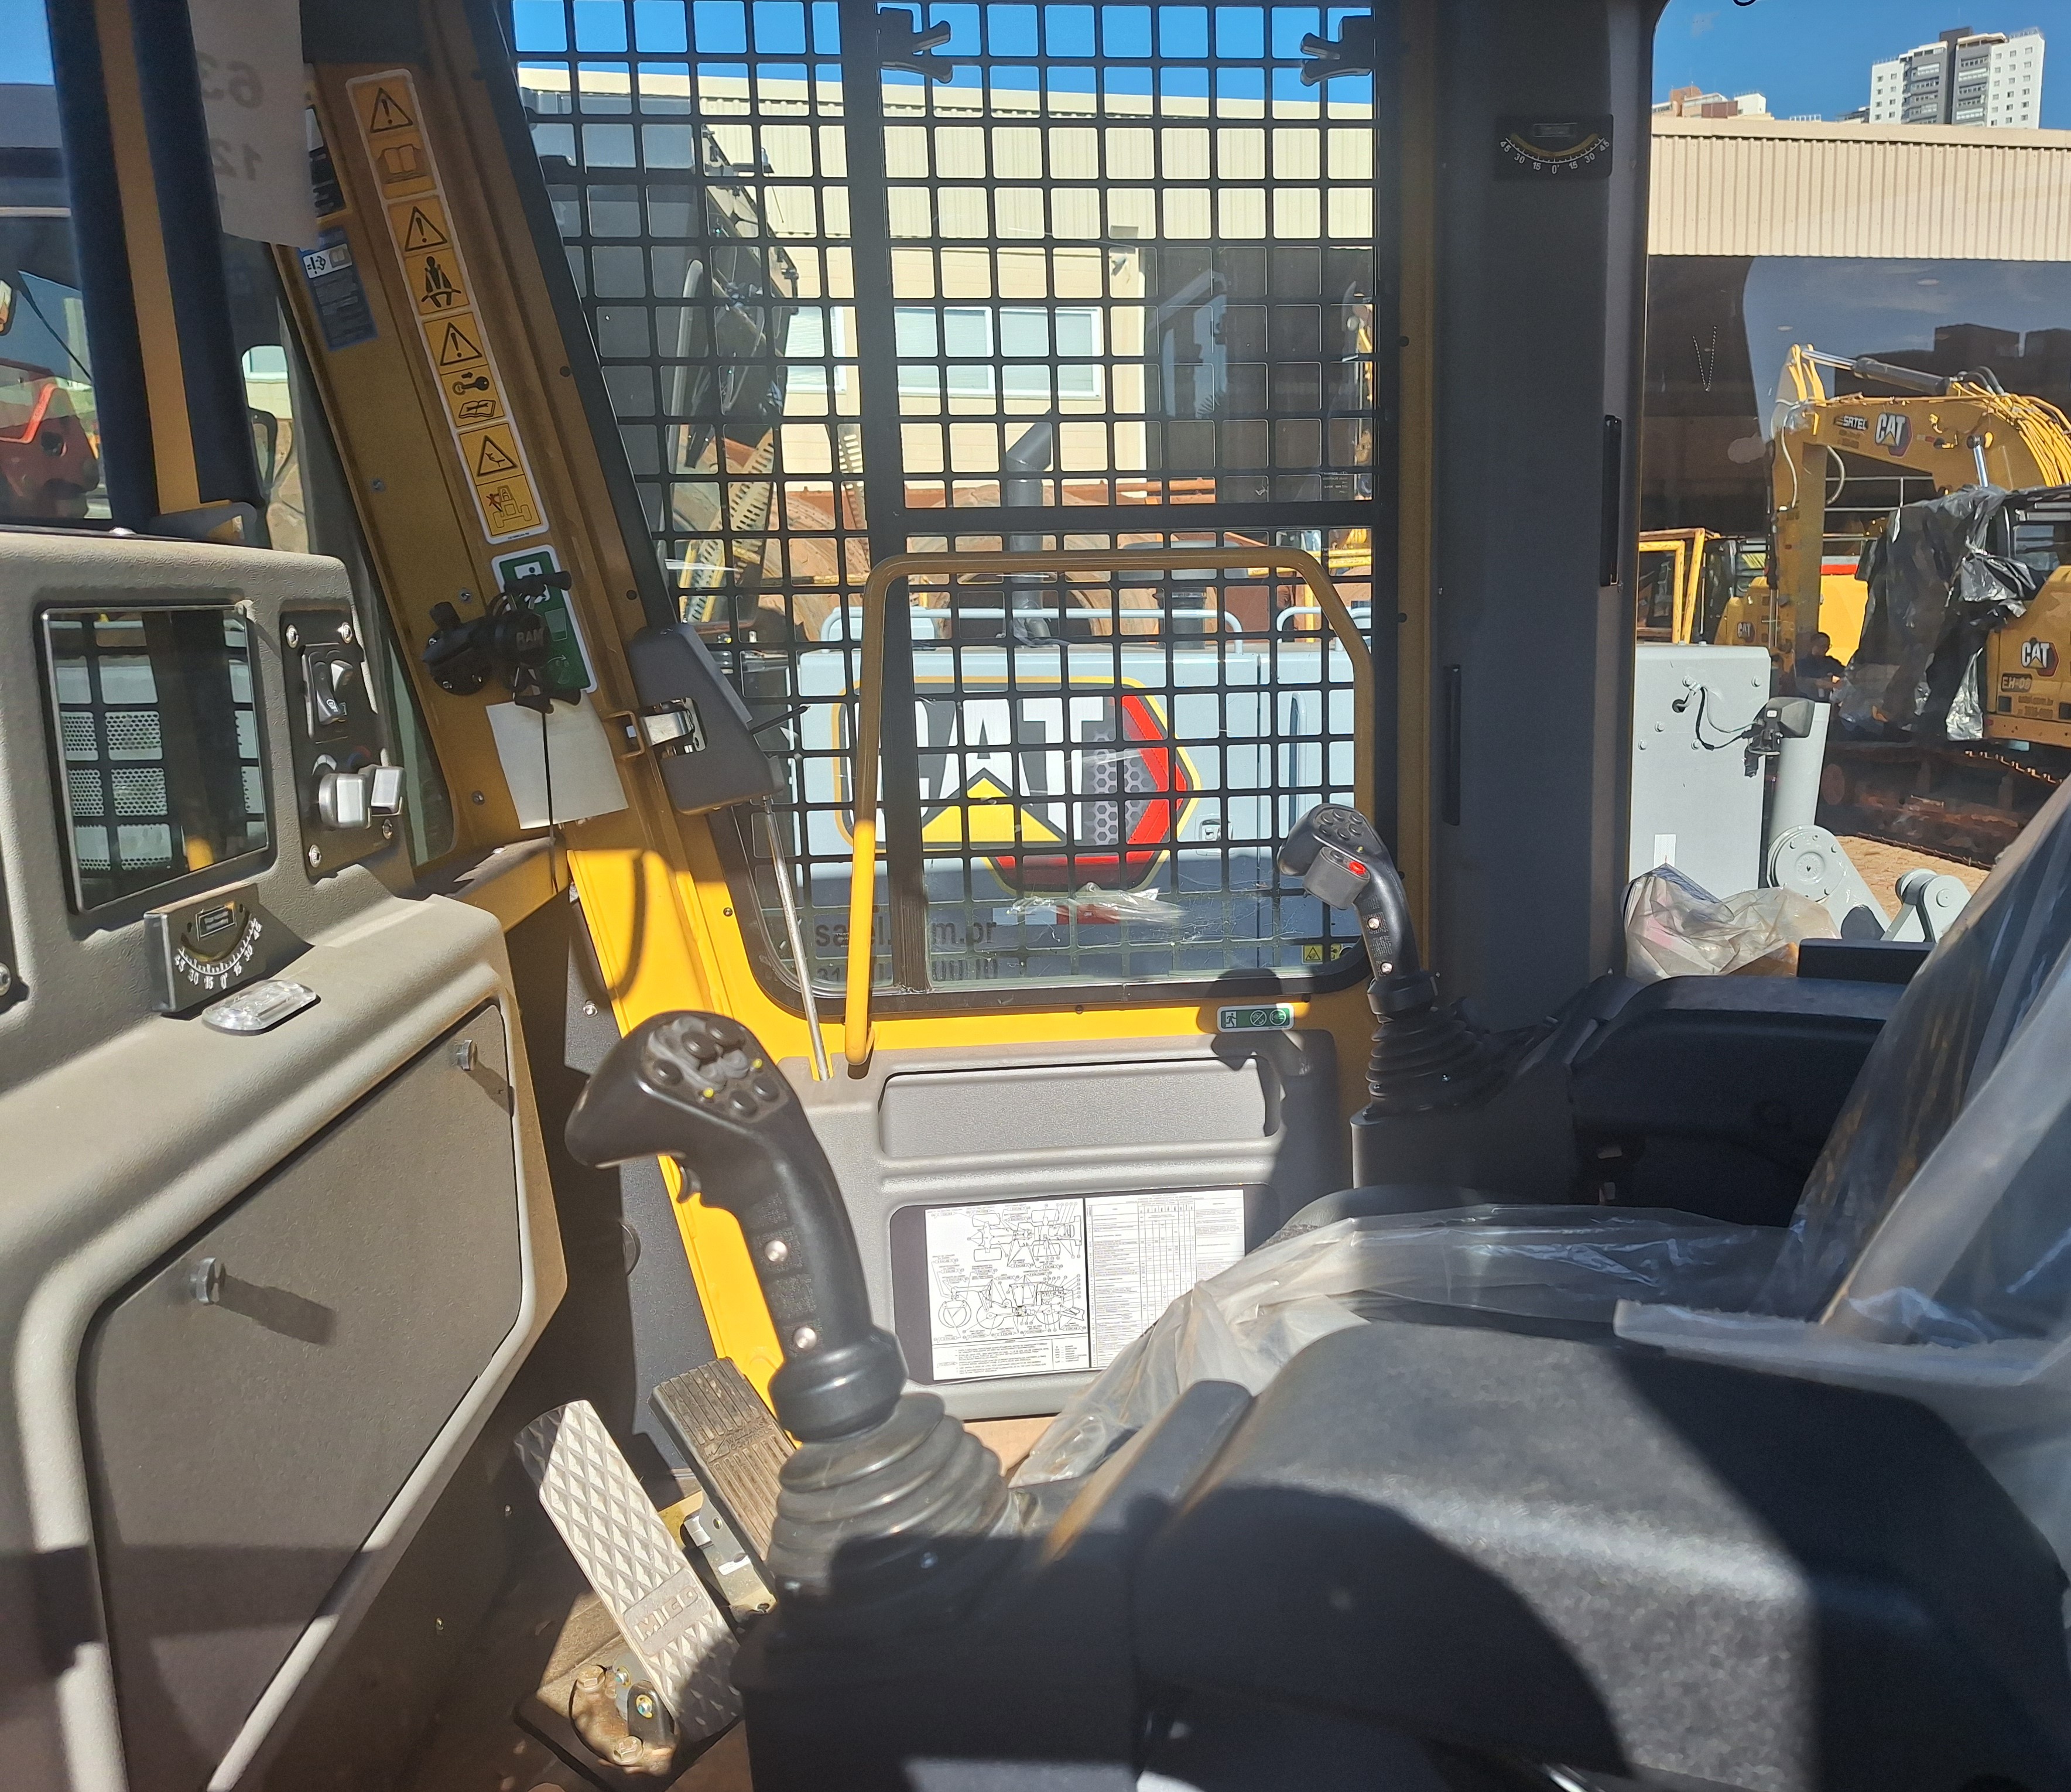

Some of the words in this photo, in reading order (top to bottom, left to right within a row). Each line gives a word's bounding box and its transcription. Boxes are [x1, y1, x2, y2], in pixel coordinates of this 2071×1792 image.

[1500, 141, 1511, 152] 45
[1514, 153, 1525, 164] 30
[1532, 162, 1542, 171] 15
[1569, 160, 1578, 170] 15
[1584, 152, 1596, 163] 30
[1599, 139, 1610, 152] 45
[1843, 415, 1867, 431] SATEL
[1875, 412, 1906, 447] CAT
[1737, 622, 1751, 638] CAT
[2022, 642, 2050, 668] CAT
[187, 969, 200, 986] 30
[204, 975, 214, 990] 15
[233, 961, 242, 977] 15
[244, 943, 253, 962] 30
[634, 1585, 699, 1642] MICO
